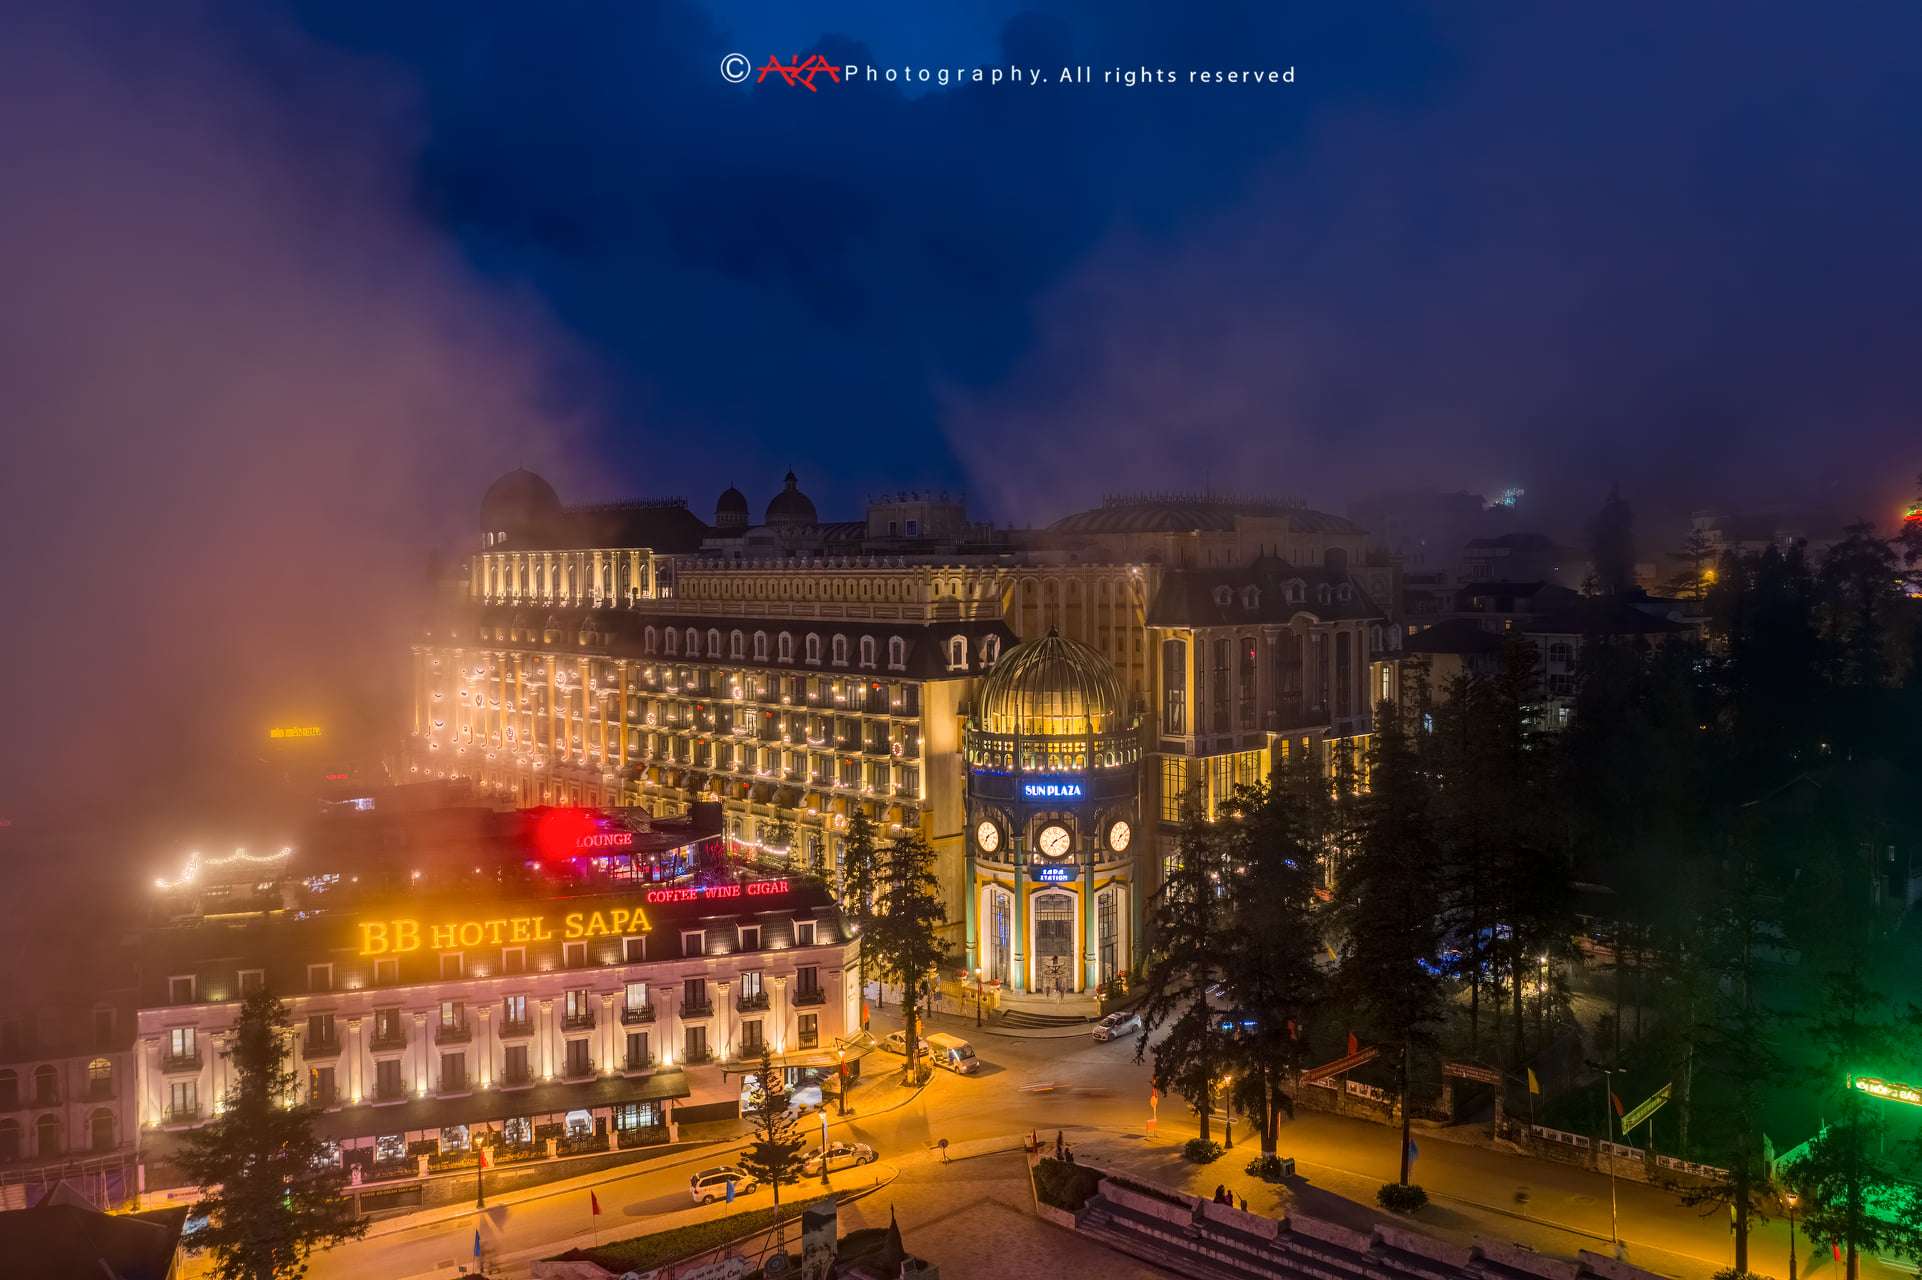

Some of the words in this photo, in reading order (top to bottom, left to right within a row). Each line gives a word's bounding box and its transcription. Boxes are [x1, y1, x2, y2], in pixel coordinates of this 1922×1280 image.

[1025, 785, 1046, 796] SUN
[1047, 785, 1081, 796] PLAZA
[576, 833, 632, 848] LOUNGE
[647, 890, 698, 903] COFFEE
[704, 885, 741, 899] WINE
[747, 881, 789, 896] CIGAR
[358, 918, 422, 956] BB
[430, 916, 552, 950] HOTEL
[565, 907, 653, 939] SAPA
